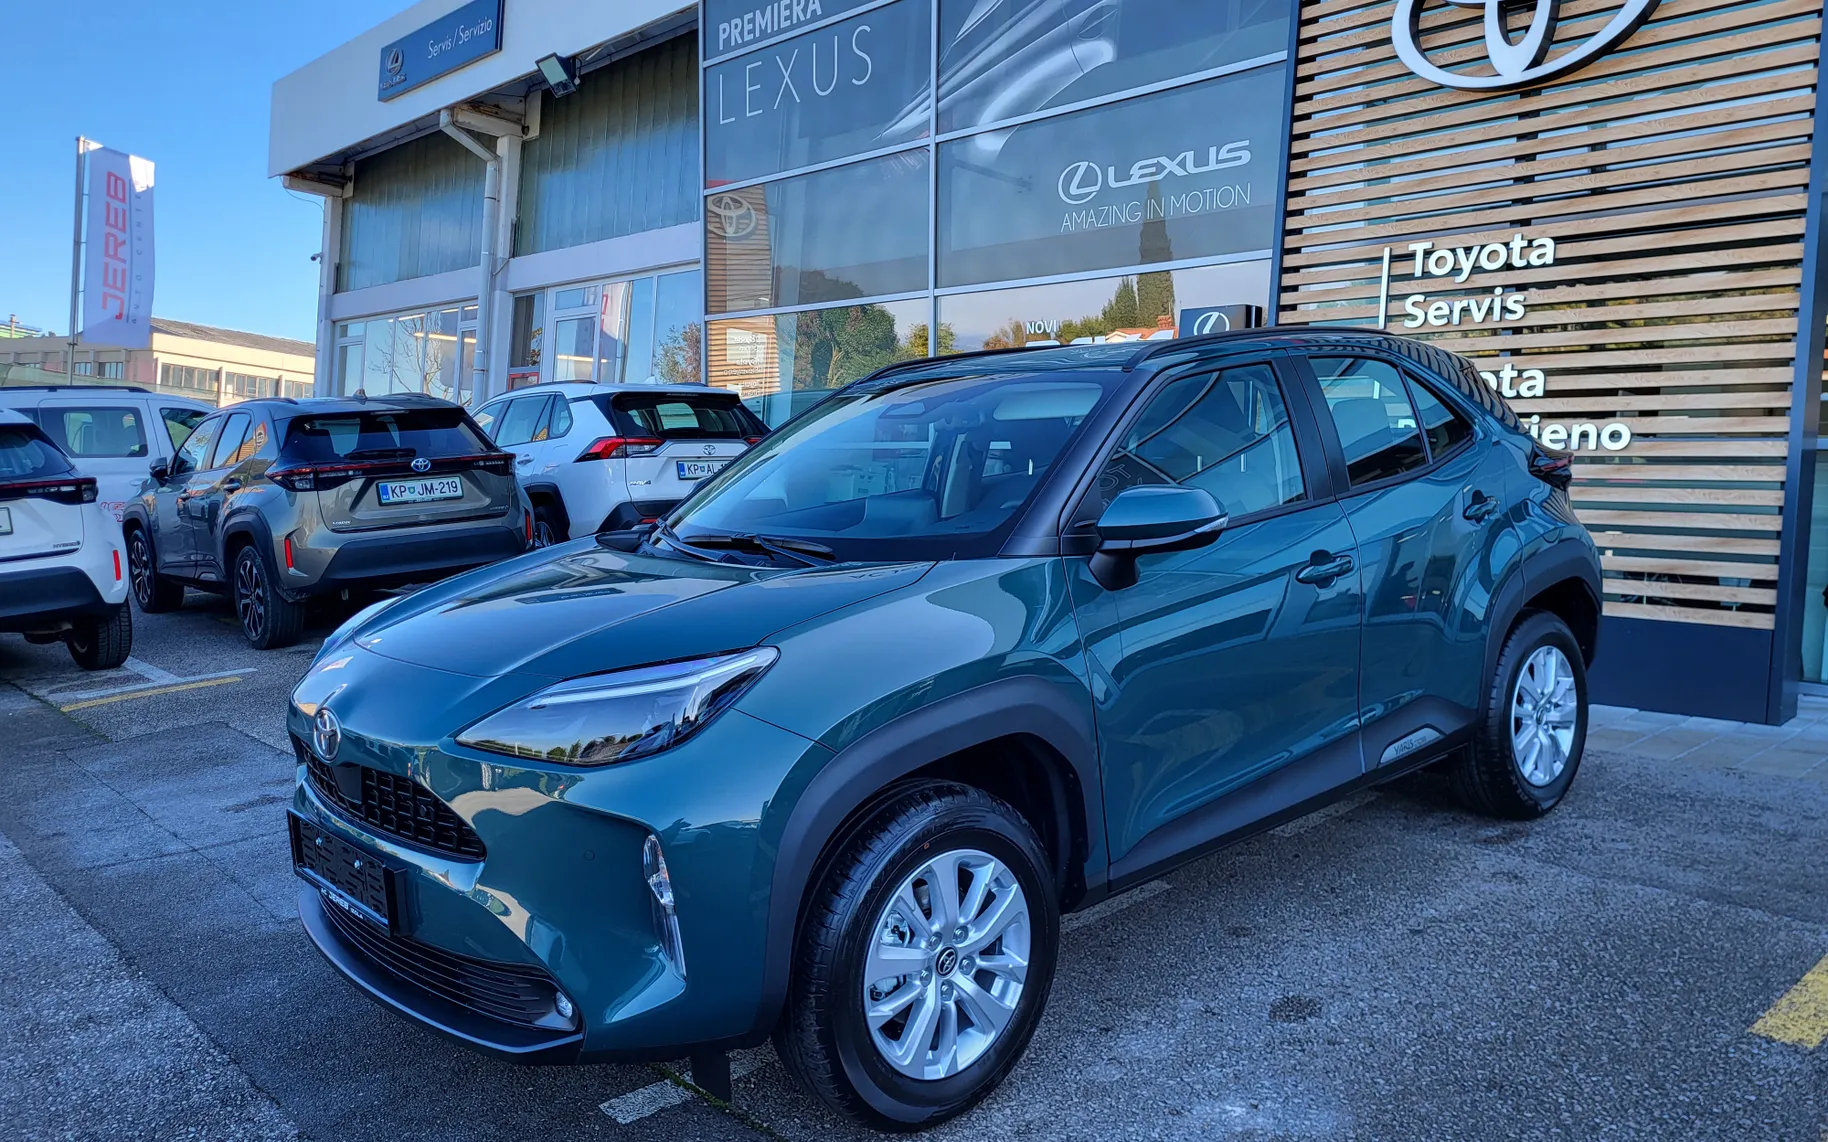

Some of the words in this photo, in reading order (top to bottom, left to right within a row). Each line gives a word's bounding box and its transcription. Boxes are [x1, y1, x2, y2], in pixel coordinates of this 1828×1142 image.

[428, 35, 452, 59] Servis
[458, 17, 493, 45] Servizio
[718, 0, 822, 50] PREMIERA
[719, 25, 872, 125] LEXUS
[1108, 139, 1251, 189] LEXUS
[1060, 201, 1142, 233] AMAZING
[1146, 197, 1165, 220] IN
[1170, 182, 1251, 216] MOTION
[102, 171, 127, 320] JEREB
[1408, 232, 1556, 284] Toyota
[1026, 320, 1058, 335] NOVI
[1403, 286, 1526, 329] Servis
[390, 483, 407, 499] KP
[417, 480, 458, 497] JM-219
[687, 463, 699, 475] KP
[1394, 739, 1414, 755] YARIS
